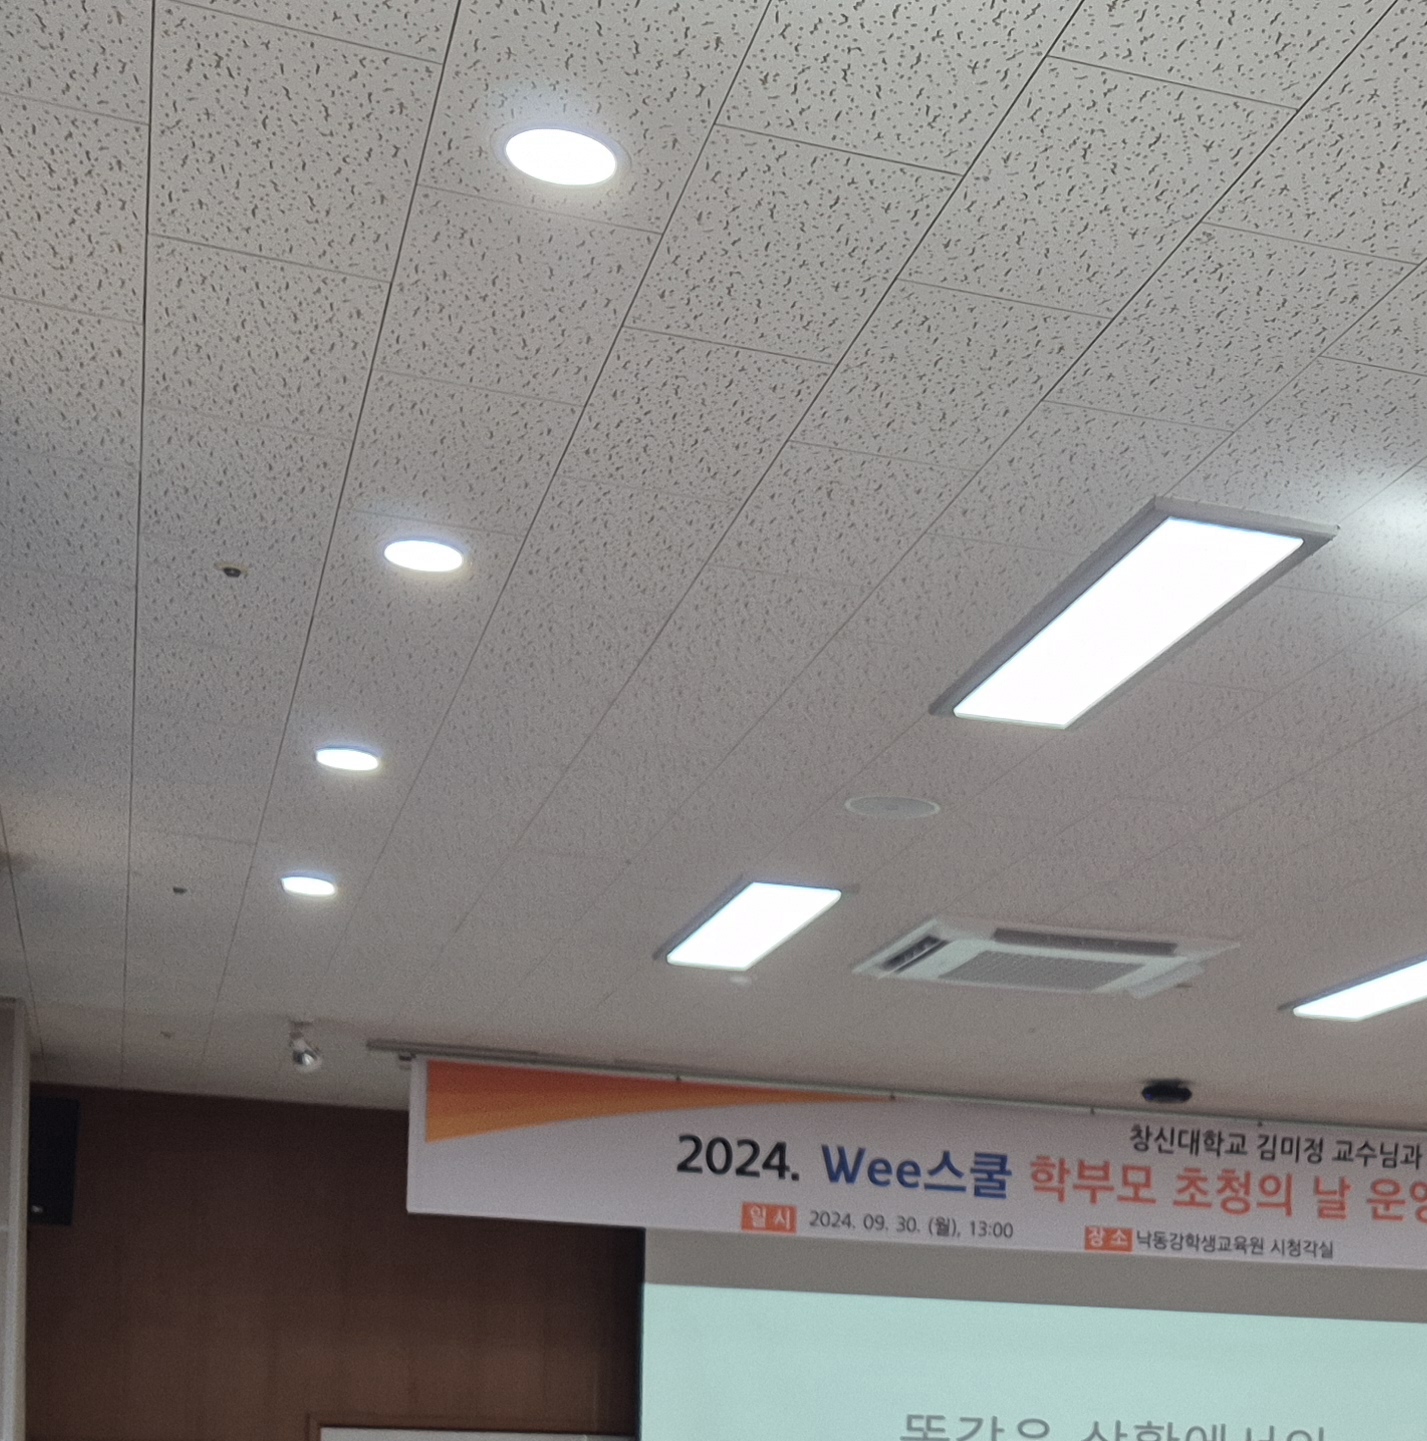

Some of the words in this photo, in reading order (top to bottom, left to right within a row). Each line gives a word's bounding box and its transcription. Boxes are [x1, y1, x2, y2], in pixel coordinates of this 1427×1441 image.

[1130, 1123, 1247, 1157] 창신대학교
[1257, 1133, 1325, 1164] 김미정
[1333, 1138, 1424, 1170] 교수님과
[675, 1133, 800, 1182] 2024.
[820, 1144, 1014, 1200] Wee스쿨
[1029, 1155, 1158, 1206] 학부모
[1172, 1165, 1294, 1216] 초청의
[1309, 1175, 1351, 1220] 날
[808, 1209, 855, 1229] 2024.
[862, 1212, 888, 1231] 09.
[896, 1215, 920, 1234] 30.
[969, 1219, 1014, 1240] 13:00
[1136, 1230, 1265, 1256] 낙동강학생교육원
[1270, 1236, 1334, 1259] 시청각실
